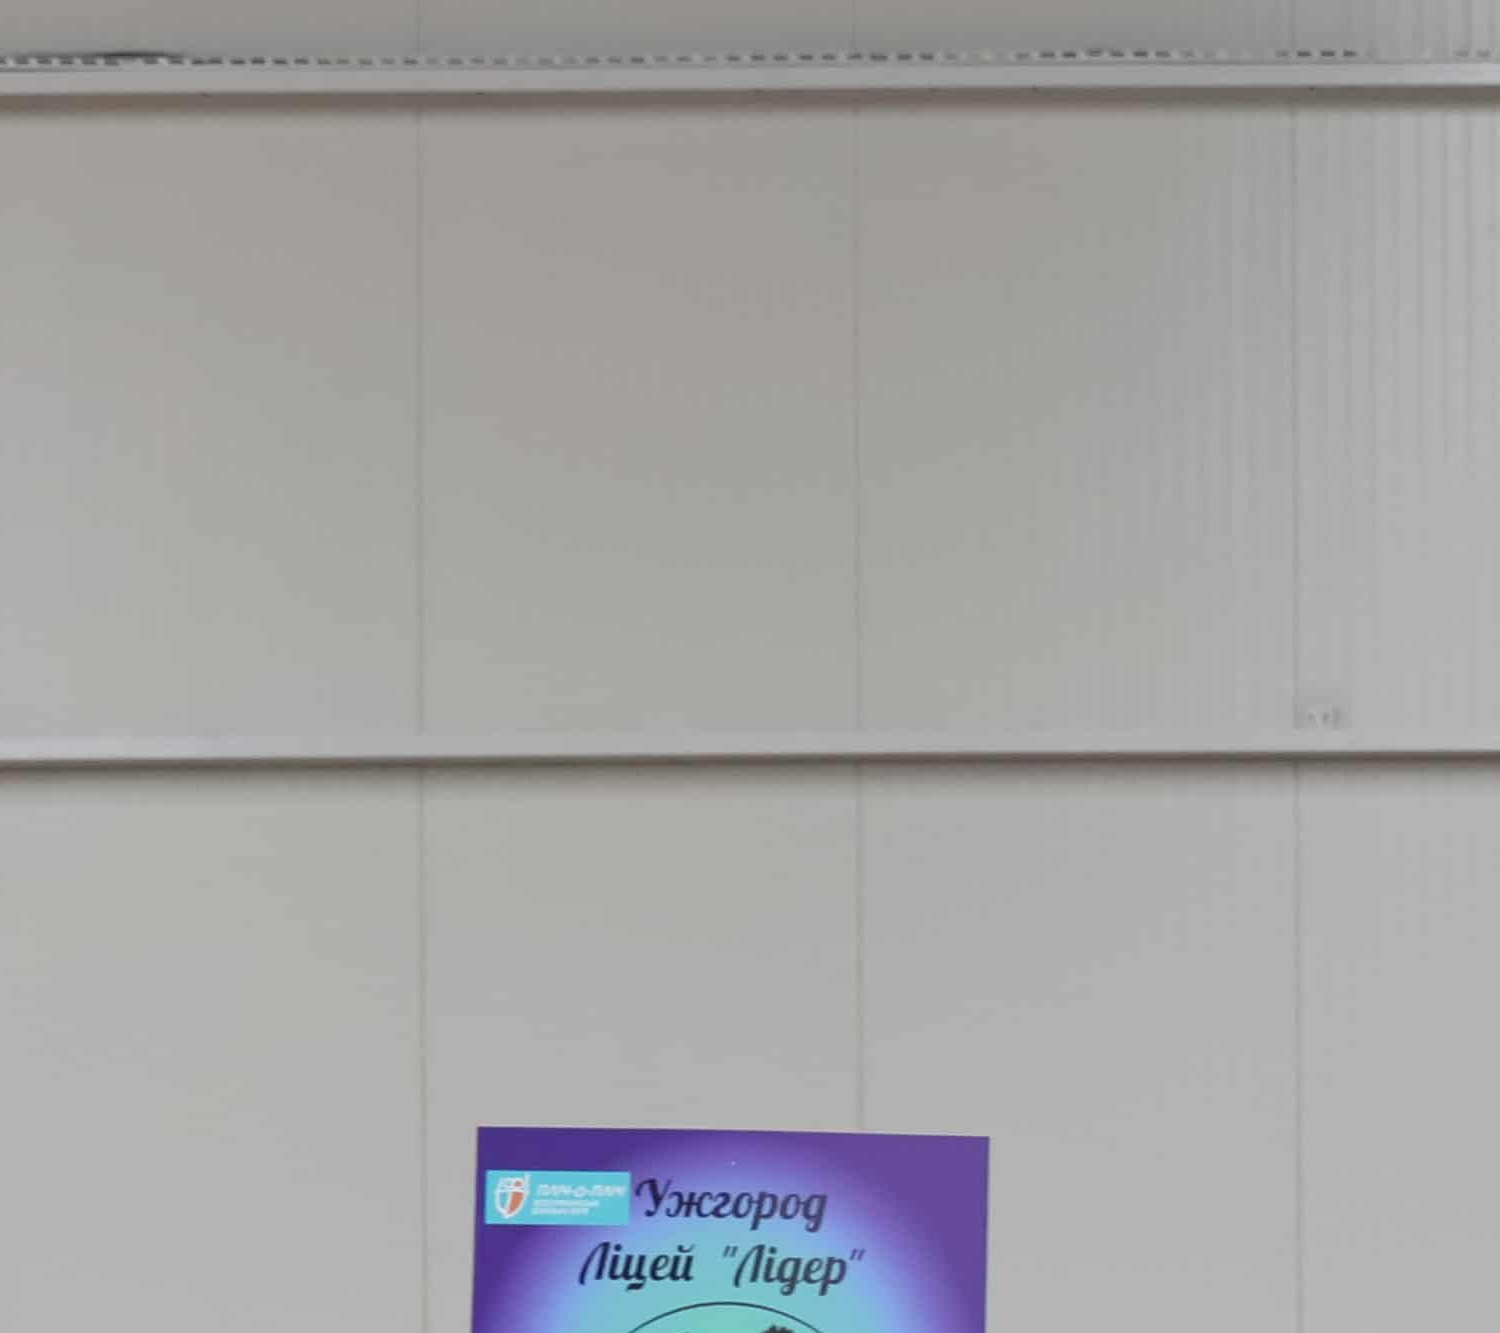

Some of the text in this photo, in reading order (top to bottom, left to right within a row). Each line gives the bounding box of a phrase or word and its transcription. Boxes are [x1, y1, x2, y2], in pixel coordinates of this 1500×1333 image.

[634, 1177, 828, 1233] Ужгород
[578, 1241, 866, 1296] Ліцей "Лідер"
